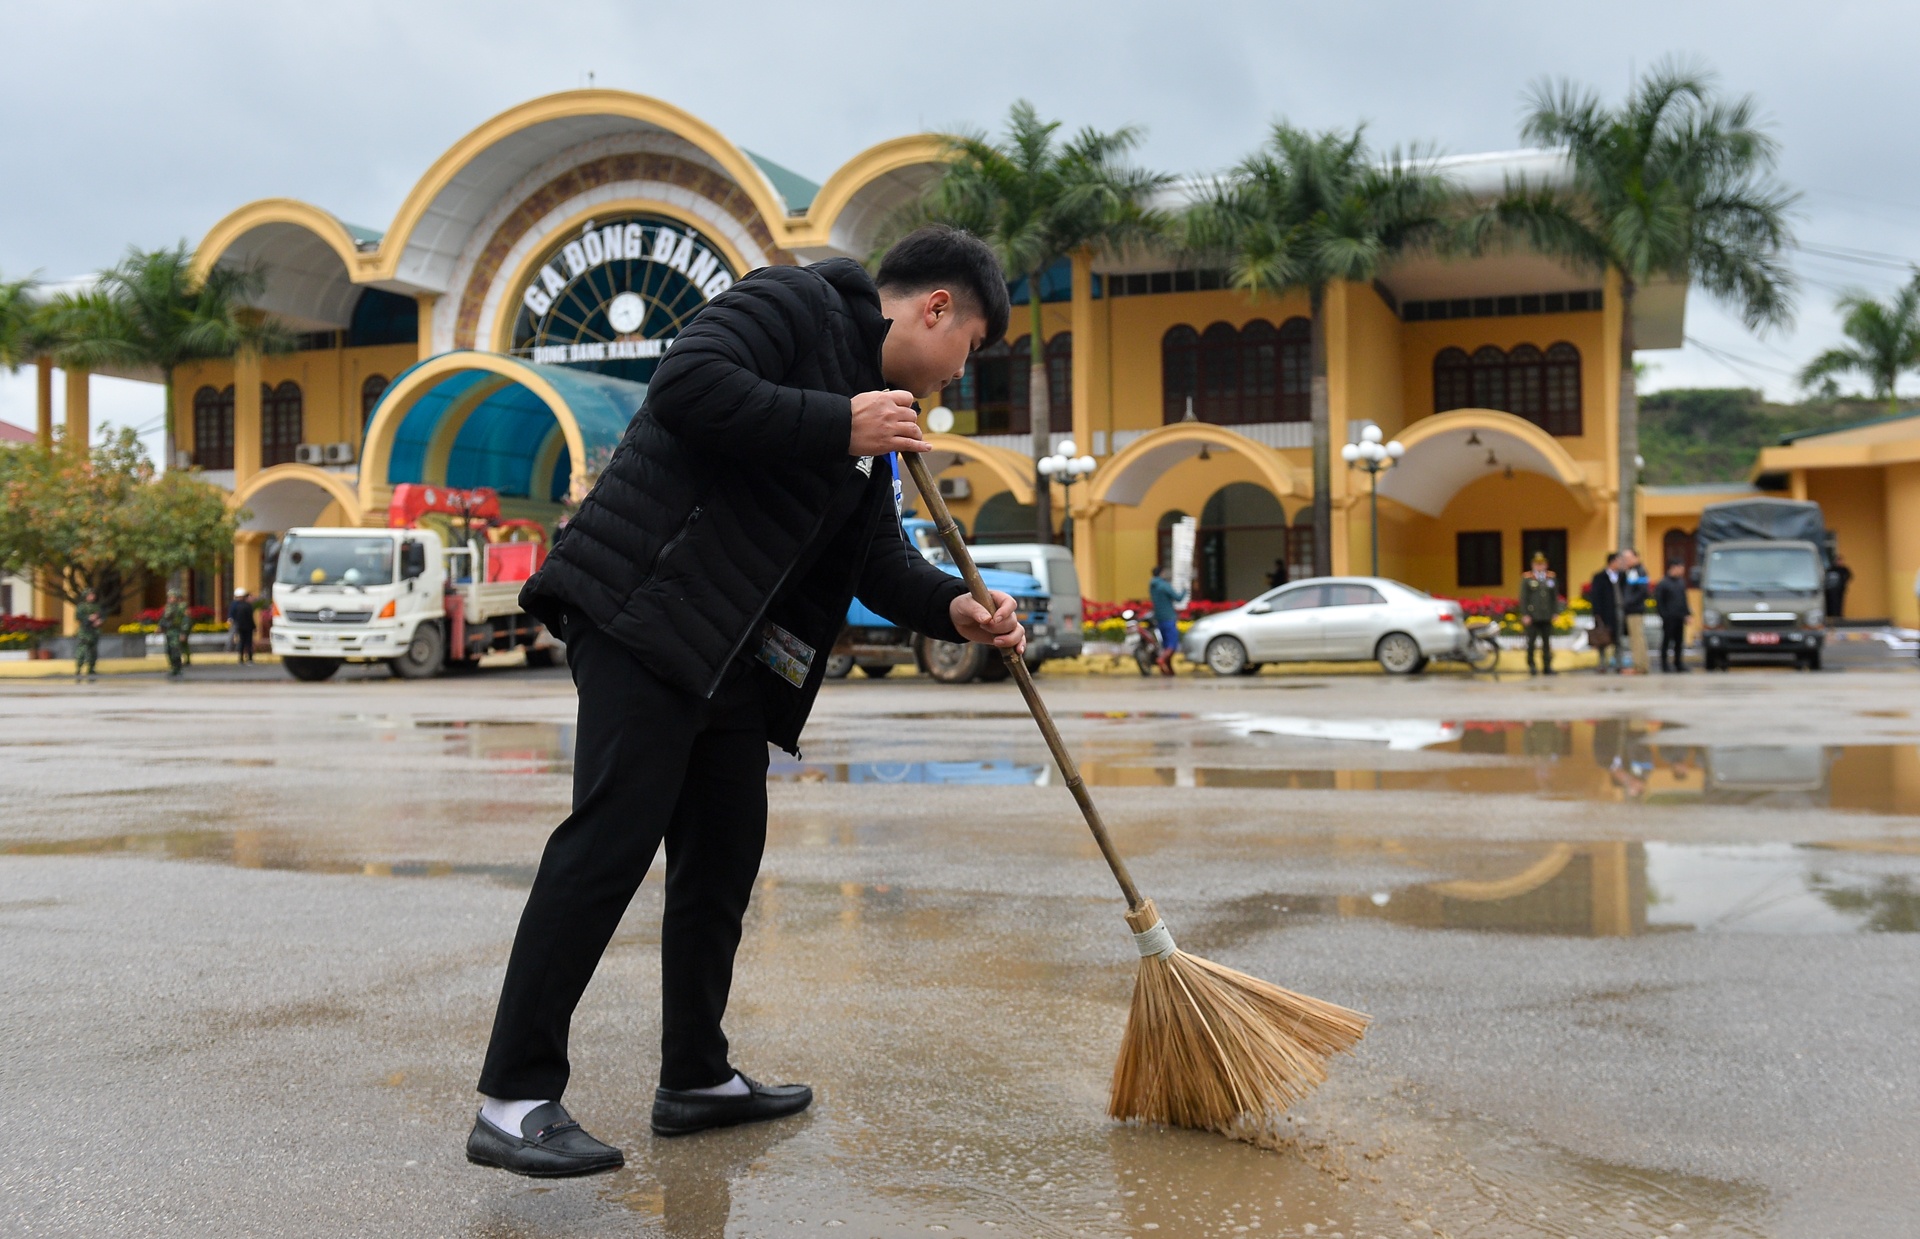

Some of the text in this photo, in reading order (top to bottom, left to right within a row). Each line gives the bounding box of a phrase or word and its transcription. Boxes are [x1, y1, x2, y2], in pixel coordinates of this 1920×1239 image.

[525, 264, 566, 316] GA
[652, 225, 733, 302] ĐĂNG
[608, 339, 661, 358] RAILWAY
